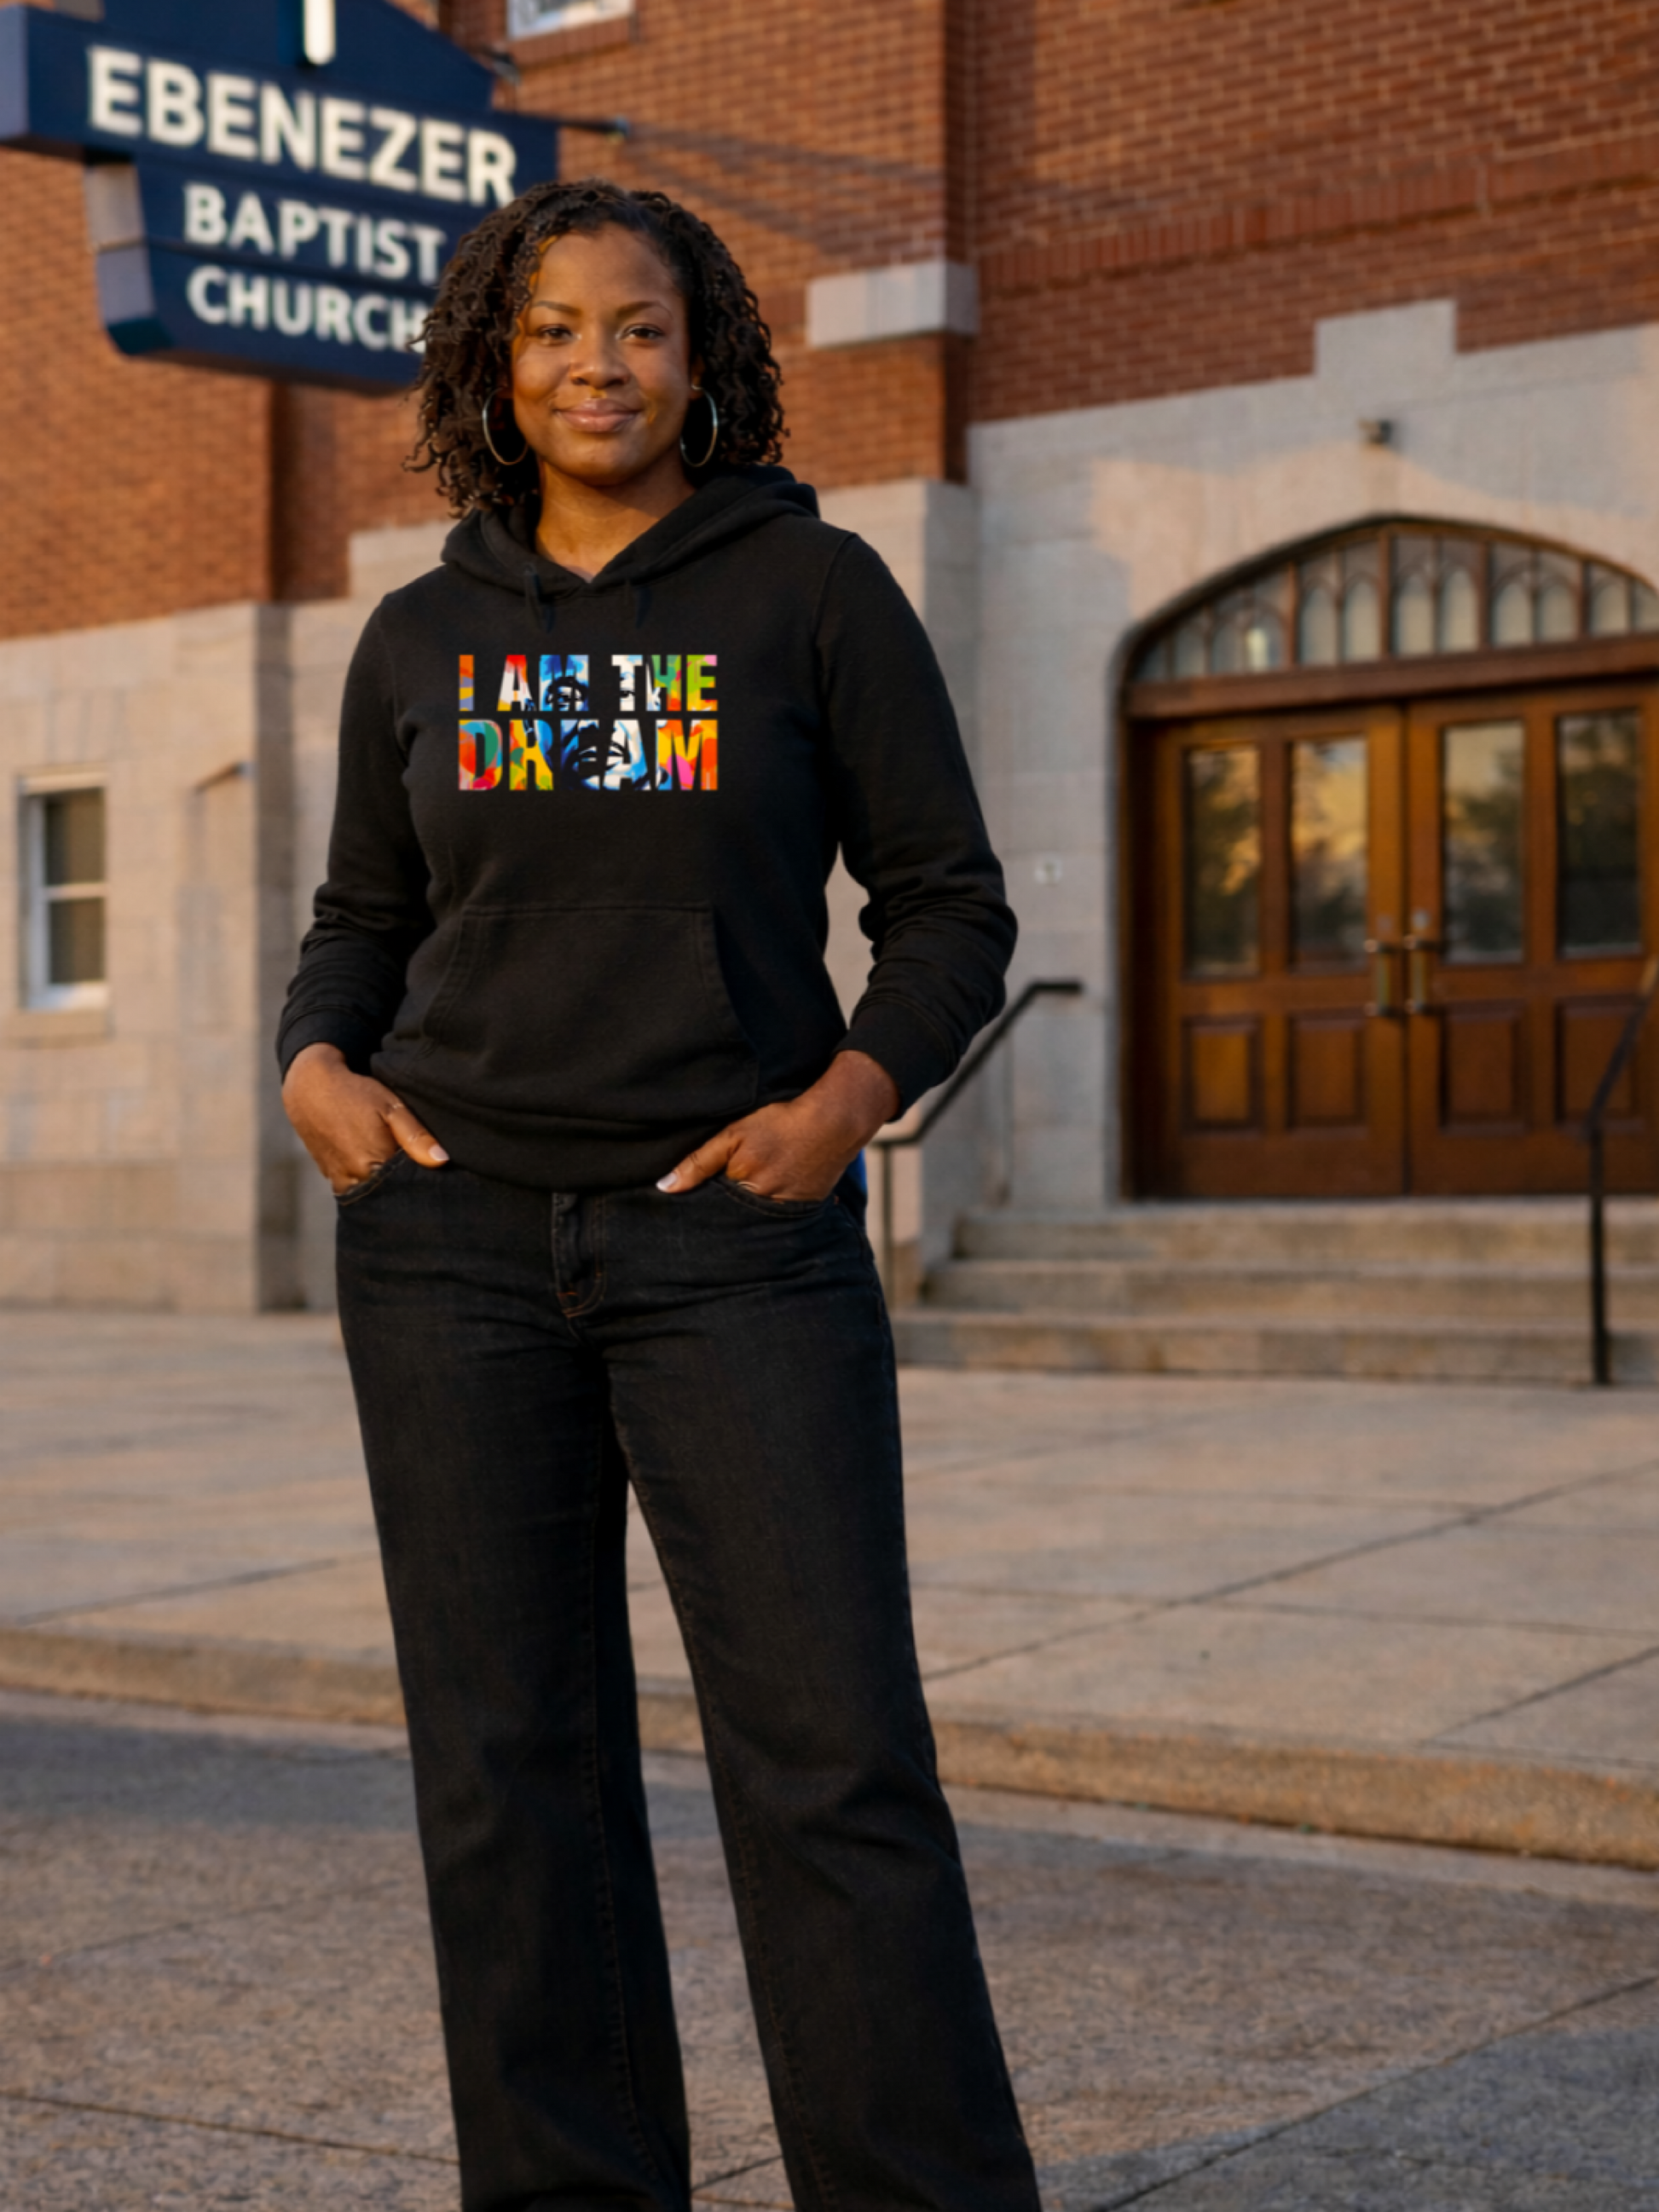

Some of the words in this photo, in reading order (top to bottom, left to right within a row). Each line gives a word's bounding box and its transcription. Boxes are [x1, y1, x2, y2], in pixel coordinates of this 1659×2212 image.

[89, 45, 517, 206] EBENEZER
[183, 182, 445, 285] BAPTIST
[187, 265, 429, 354] CHURCH
[459, 655, 474, 712] I
[497, 655, 589, 712] AM
[611, 655, 718, 712] THE
